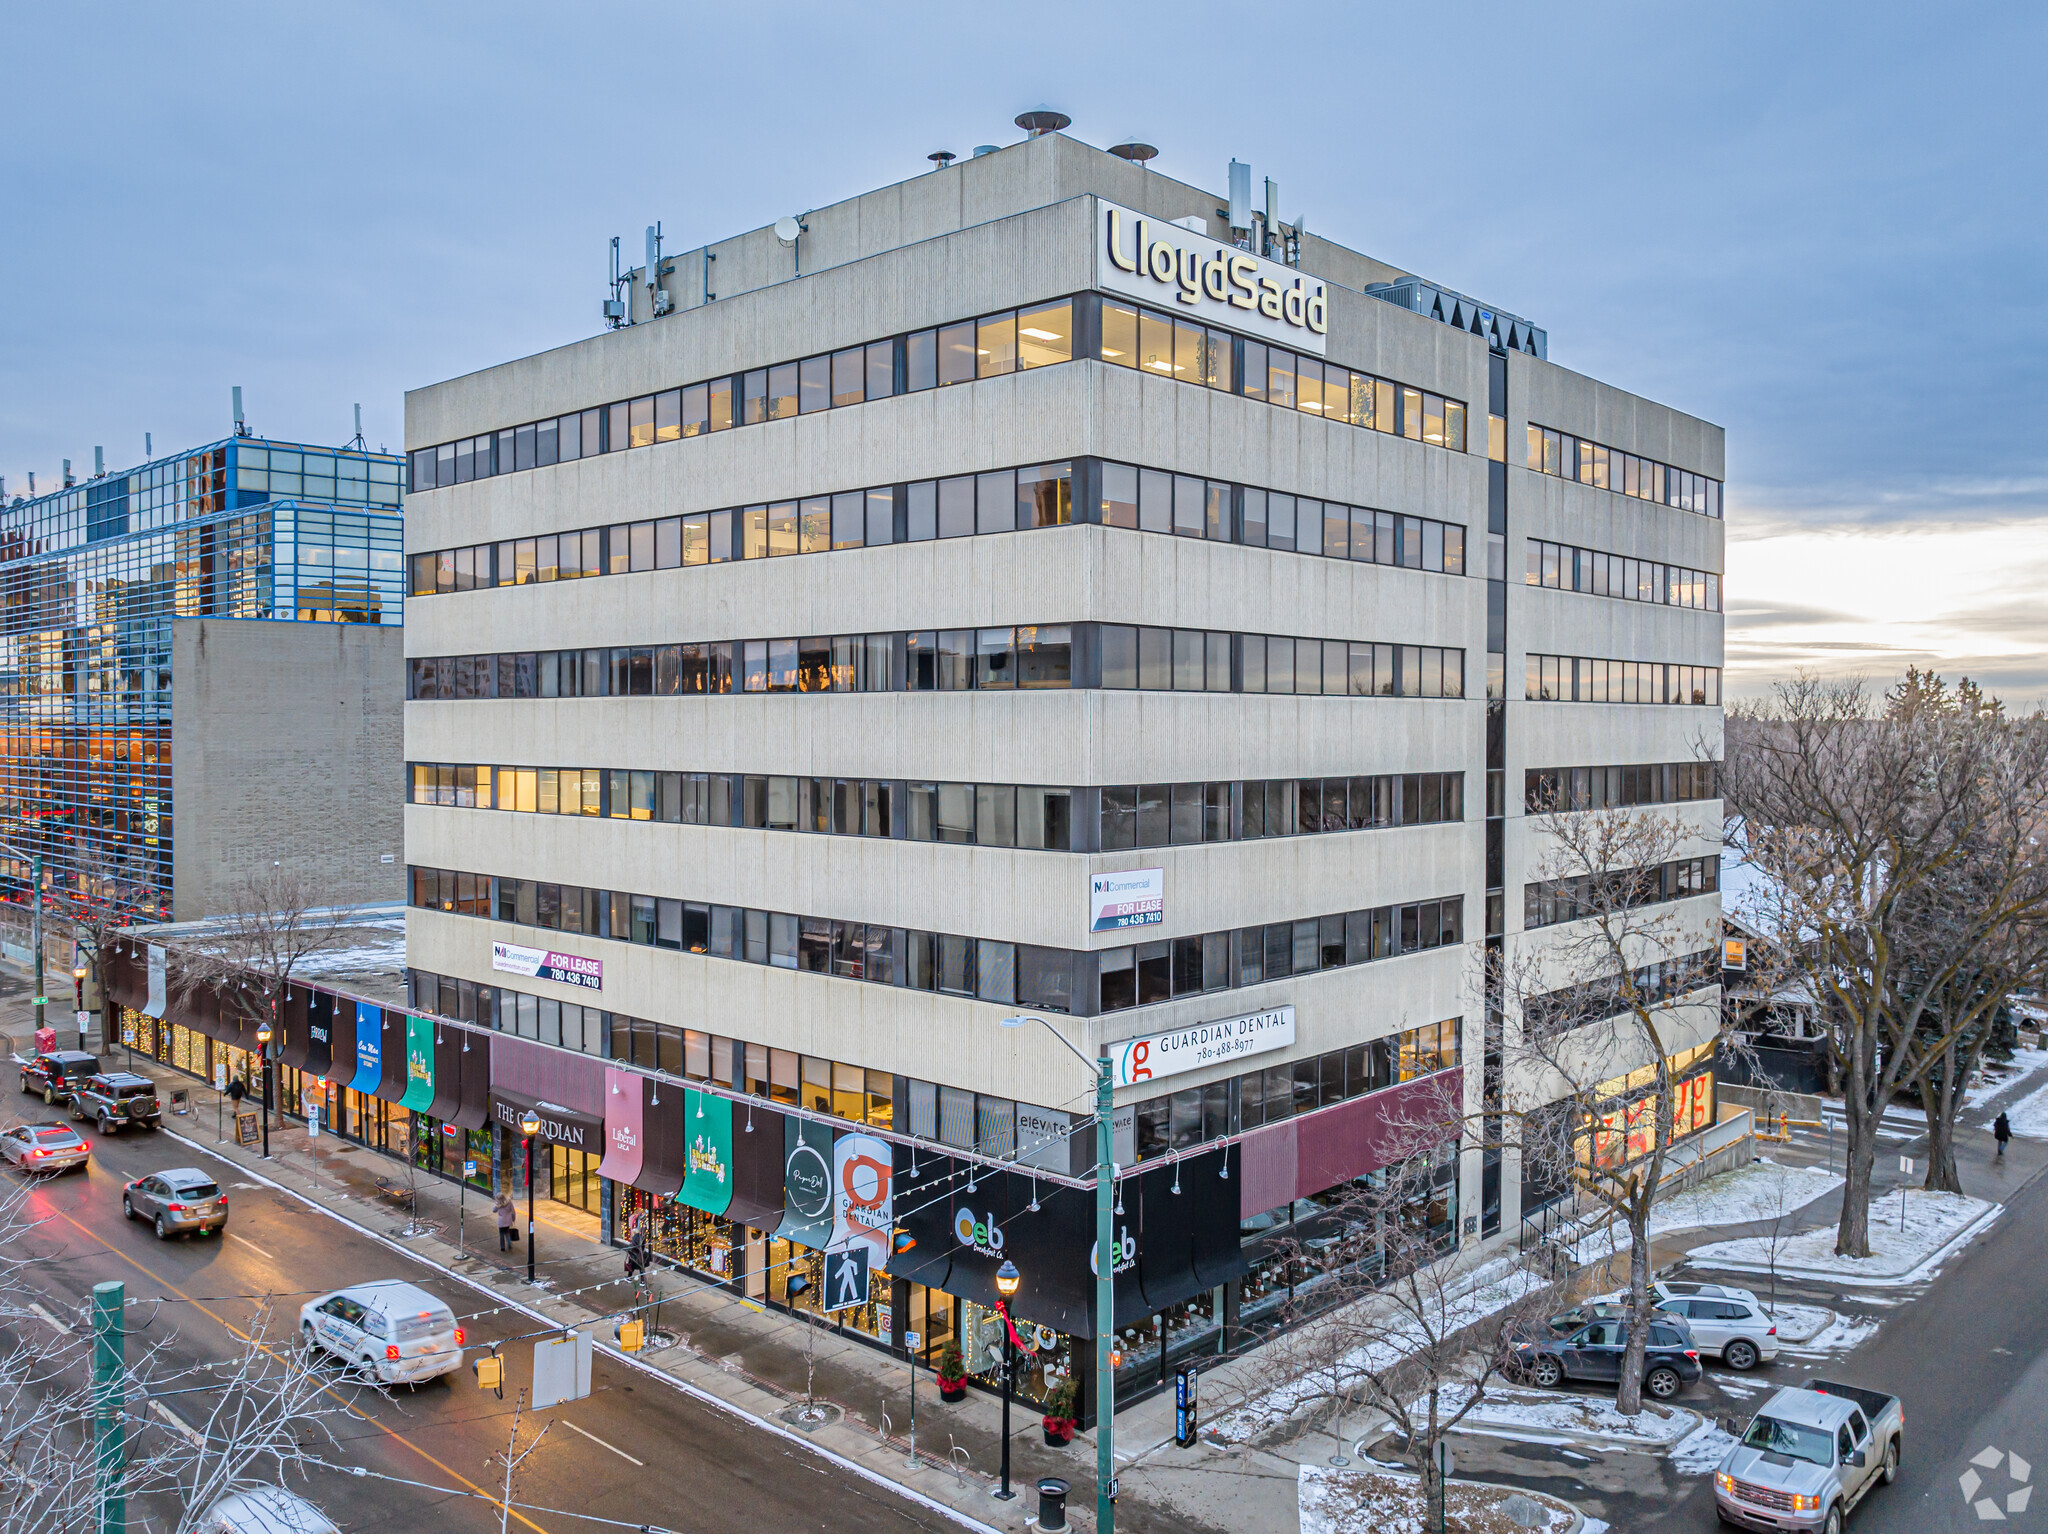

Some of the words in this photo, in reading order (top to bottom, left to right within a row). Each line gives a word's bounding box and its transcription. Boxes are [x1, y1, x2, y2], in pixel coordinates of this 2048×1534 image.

[1107, 209, 1328, 335] LloydSadd
[1117, 903, 1135, 915] FOR
[1136, 900, 1162, 912] LEASE
[1117, 918, 1129, 926] 780
[1129, 914, 1144, 925] 436
[1145, 912, 1162, 923] 7410
[550, 954, 569, 969] FOR
[570, 958, 599, 975] LEASE
[550, 969, 565, 981] 780
[566, 972, 581, 984] 436
[582, 975, 600, 988] 7410
[1160, 1023, 1232, 1053] GUARDIAN
[1238, 1011, 1286, 1035] DENTAL
[1196, 1038, 1254, 1064] 780-488-8977
[496, 1102, 515, 1125] THE
[517, 1111, 585, 1145] GRDIAN
[612, 1127, 636, 1147] Liberal
[842, 1198, 889, 1220] GUARDIAN
[842, 1209, 876, 1228] DENTAL
